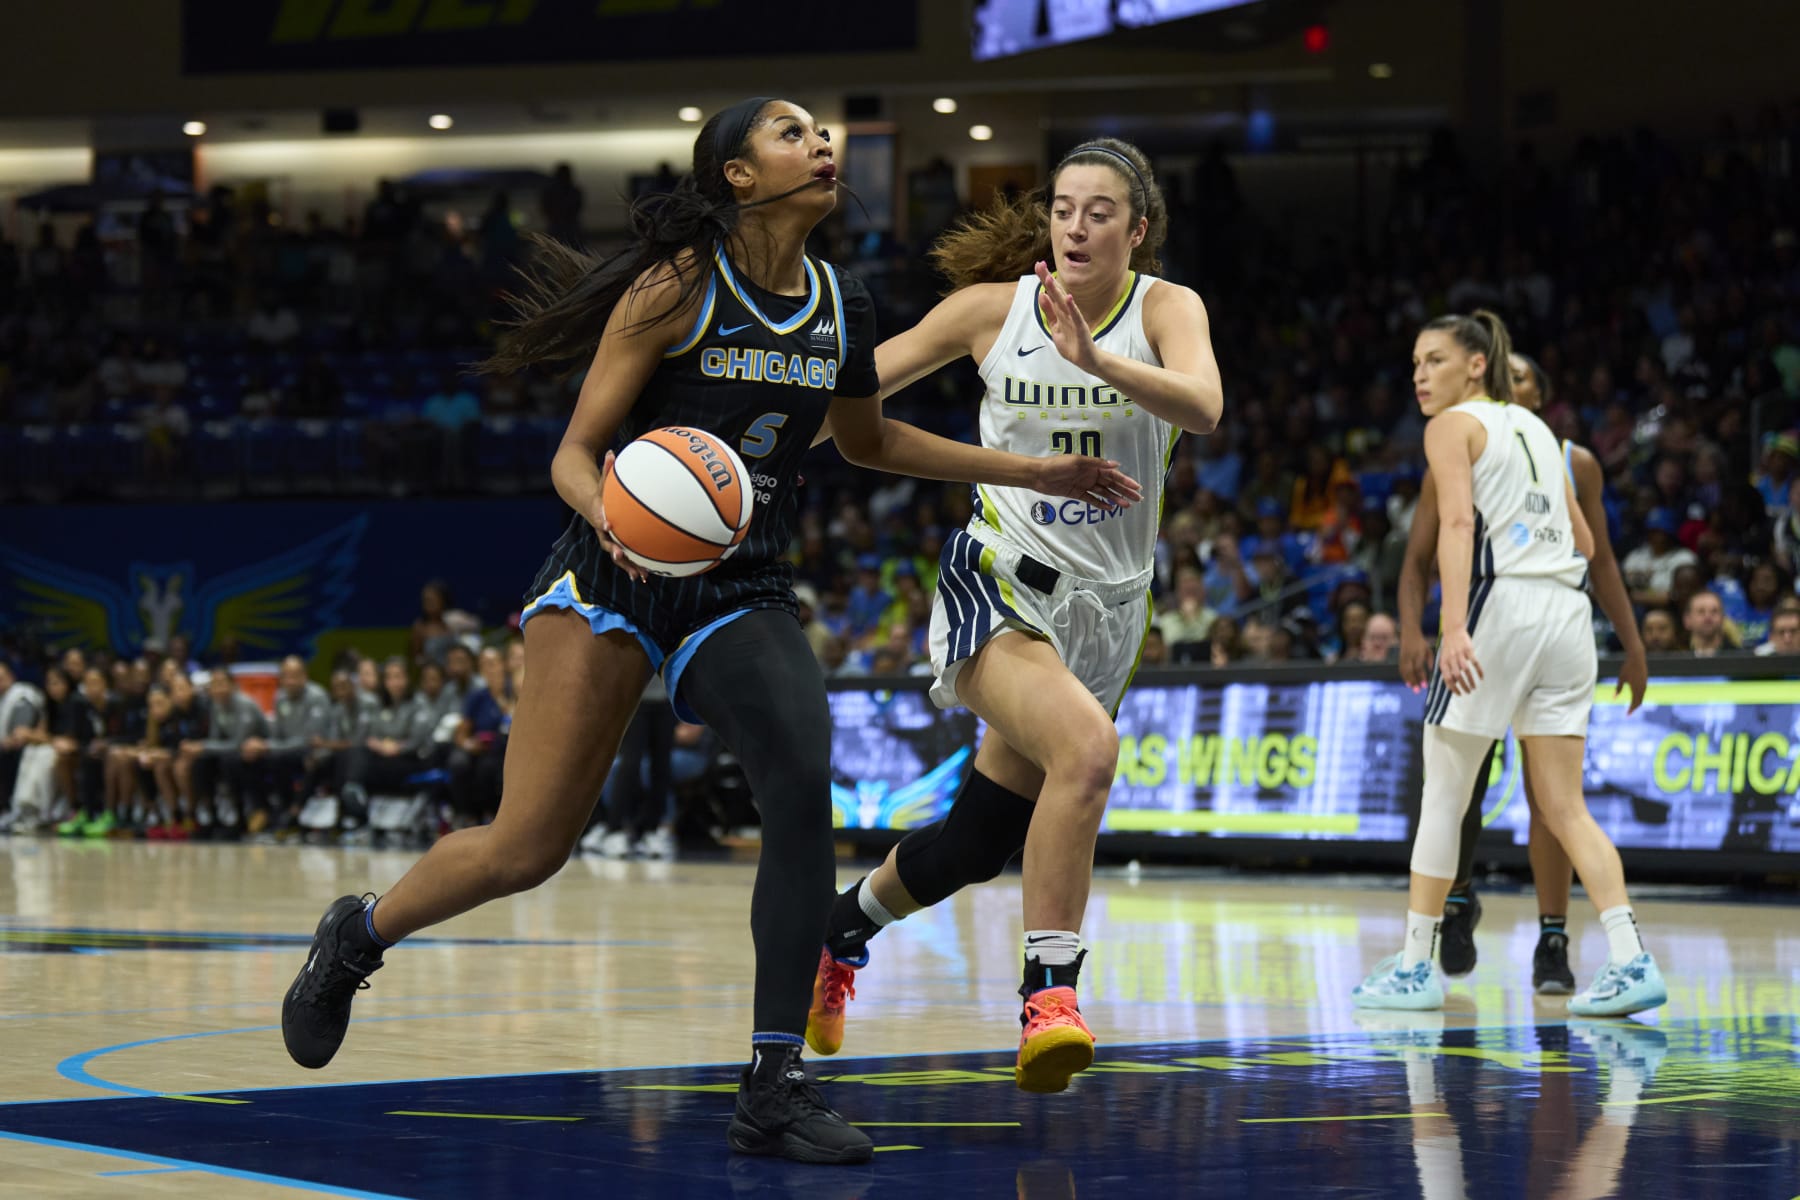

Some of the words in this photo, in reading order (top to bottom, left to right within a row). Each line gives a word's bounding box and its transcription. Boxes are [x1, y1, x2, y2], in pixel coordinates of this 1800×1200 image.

[701, 347, 837, 390] CHICAGO
[740, 412, 789, 458] 5
[1017, 409, 1133, 420] DALLAS
[661, 427, 733, 492] Wilson
[1514, 430, 1540, 485] 1
[1059, 499, 1123, 525] GEM
[1534, 526, 1562, 544] AT&T
[1178, 733, 1318, 788] WINGS
